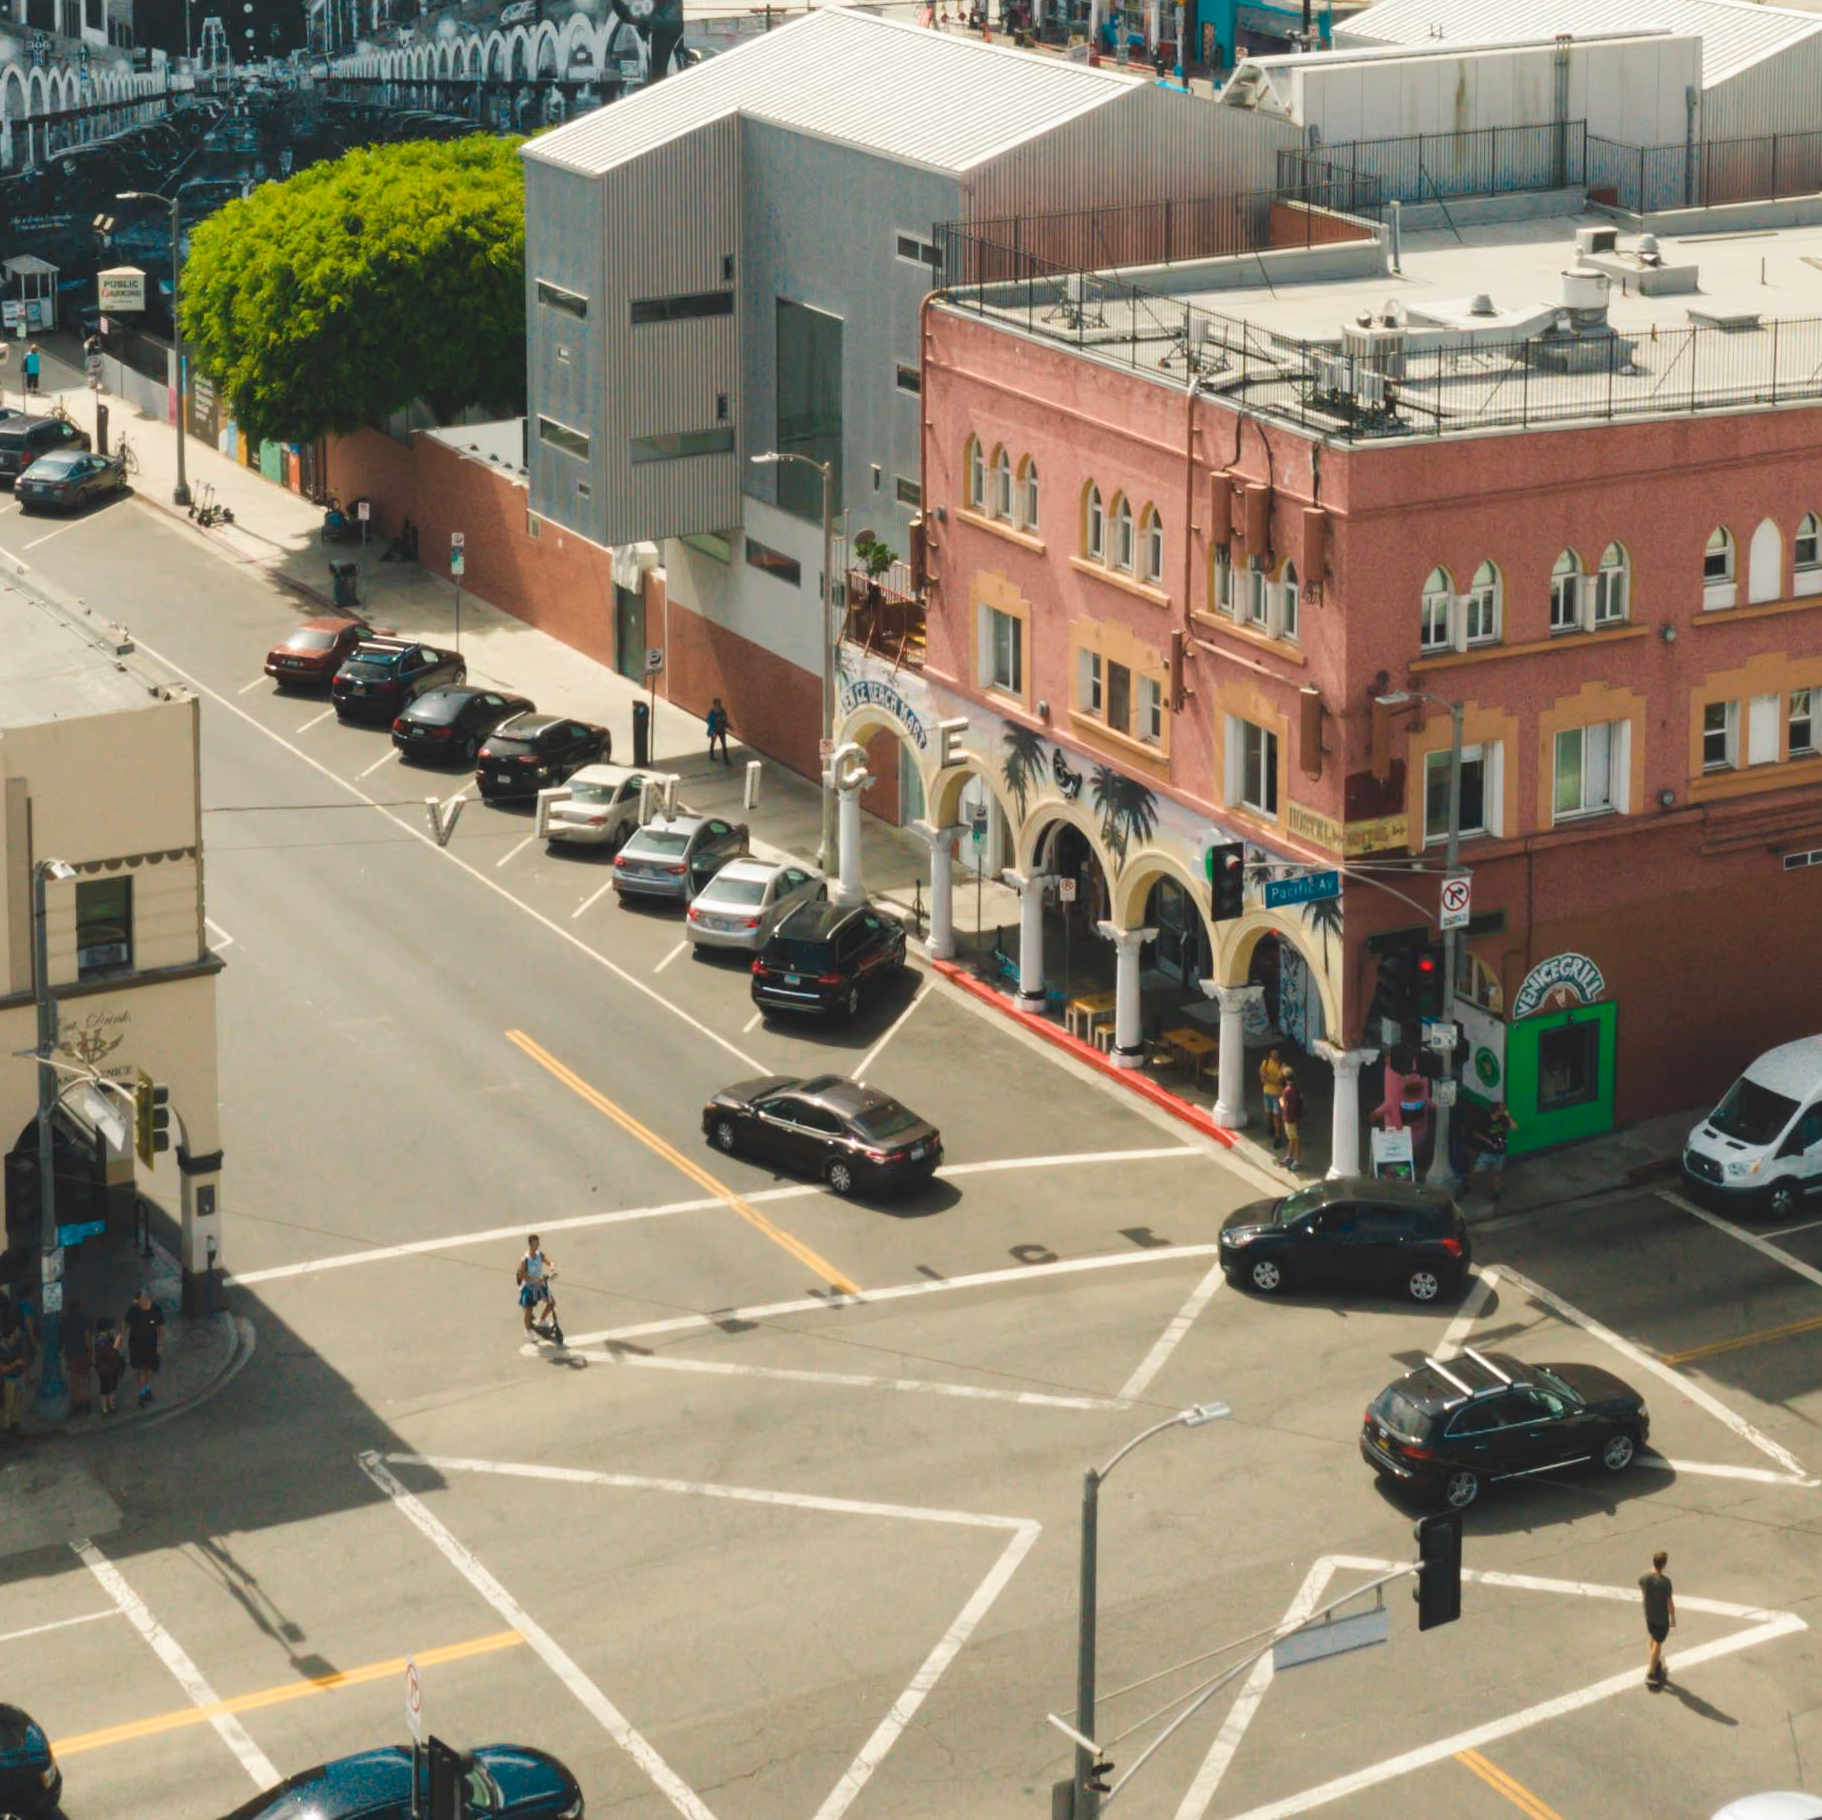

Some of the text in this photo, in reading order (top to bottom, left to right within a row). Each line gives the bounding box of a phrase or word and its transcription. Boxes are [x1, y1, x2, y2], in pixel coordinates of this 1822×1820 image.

[103, 279, 139, 289] PUBLIC
[1271, 878, 1334, 901] Pacific Av
